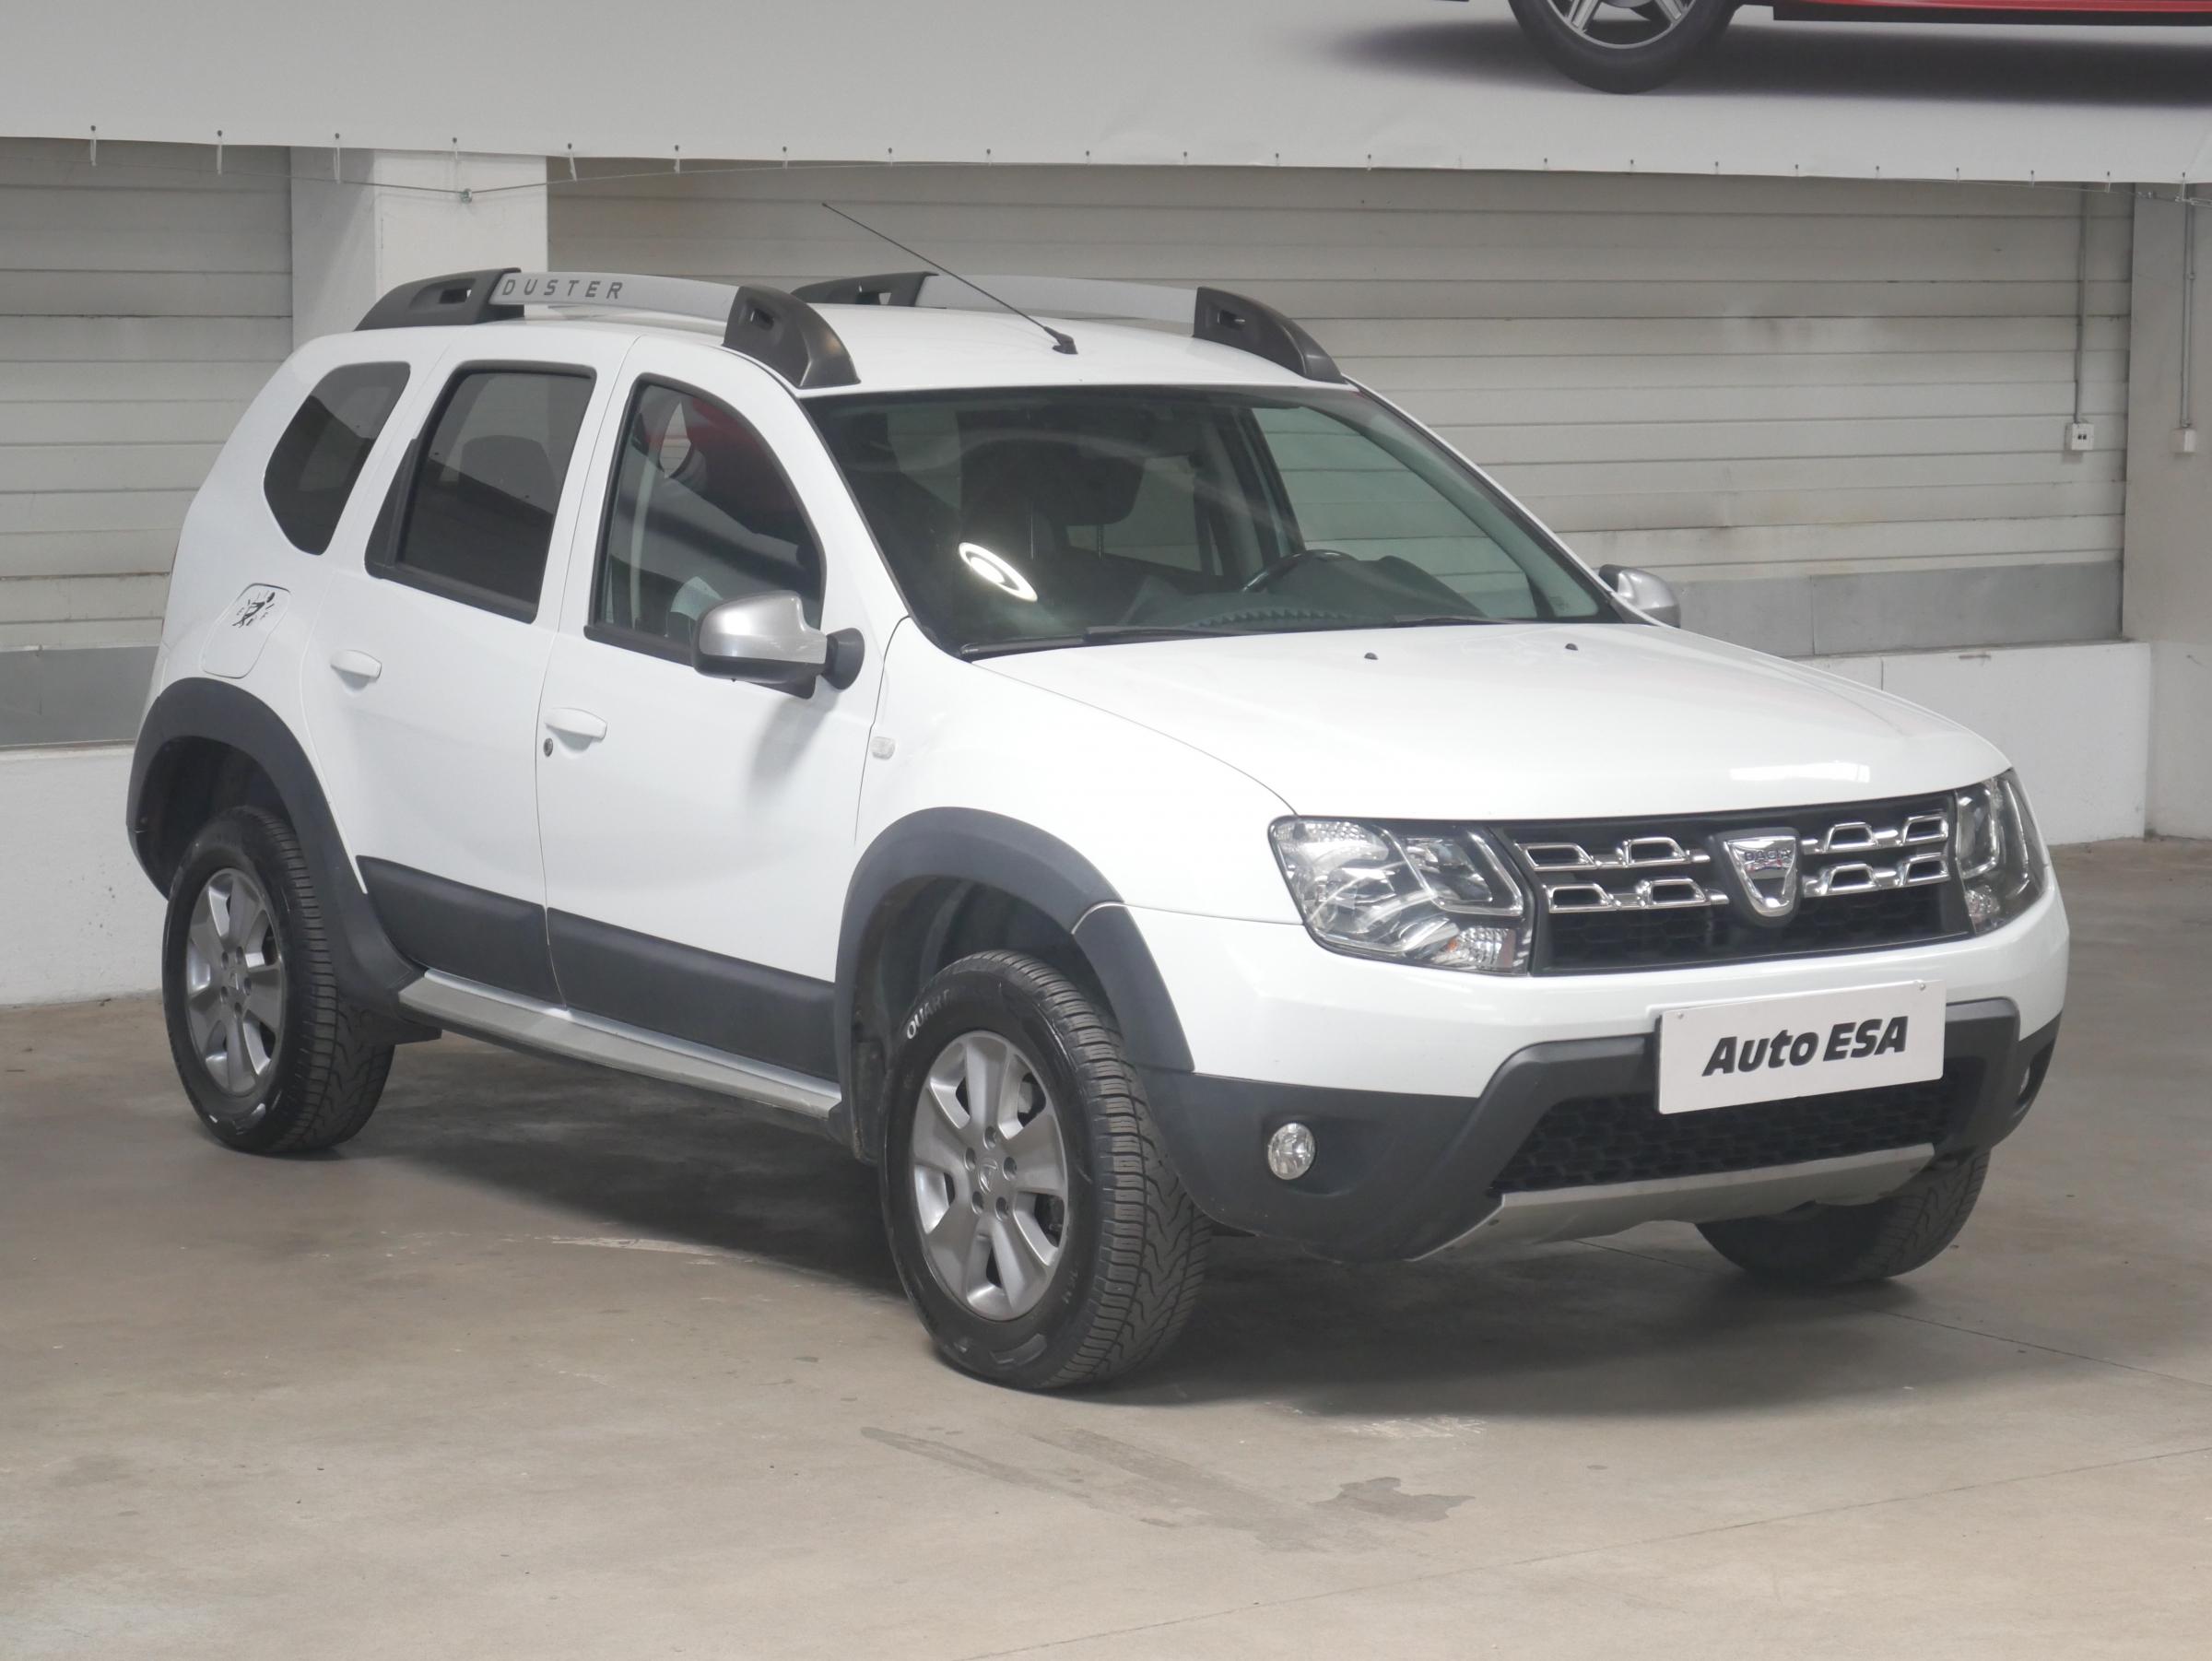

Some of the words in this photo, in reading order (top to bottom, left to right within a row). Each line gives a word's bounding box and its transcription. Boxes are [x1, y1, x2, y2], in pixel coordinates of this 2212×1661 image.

[501, 278, 623, 300] DUSTER
[1701, 1029, 1819, 1078] Auto
[1822, 1015, 1909, 1062] ESA
